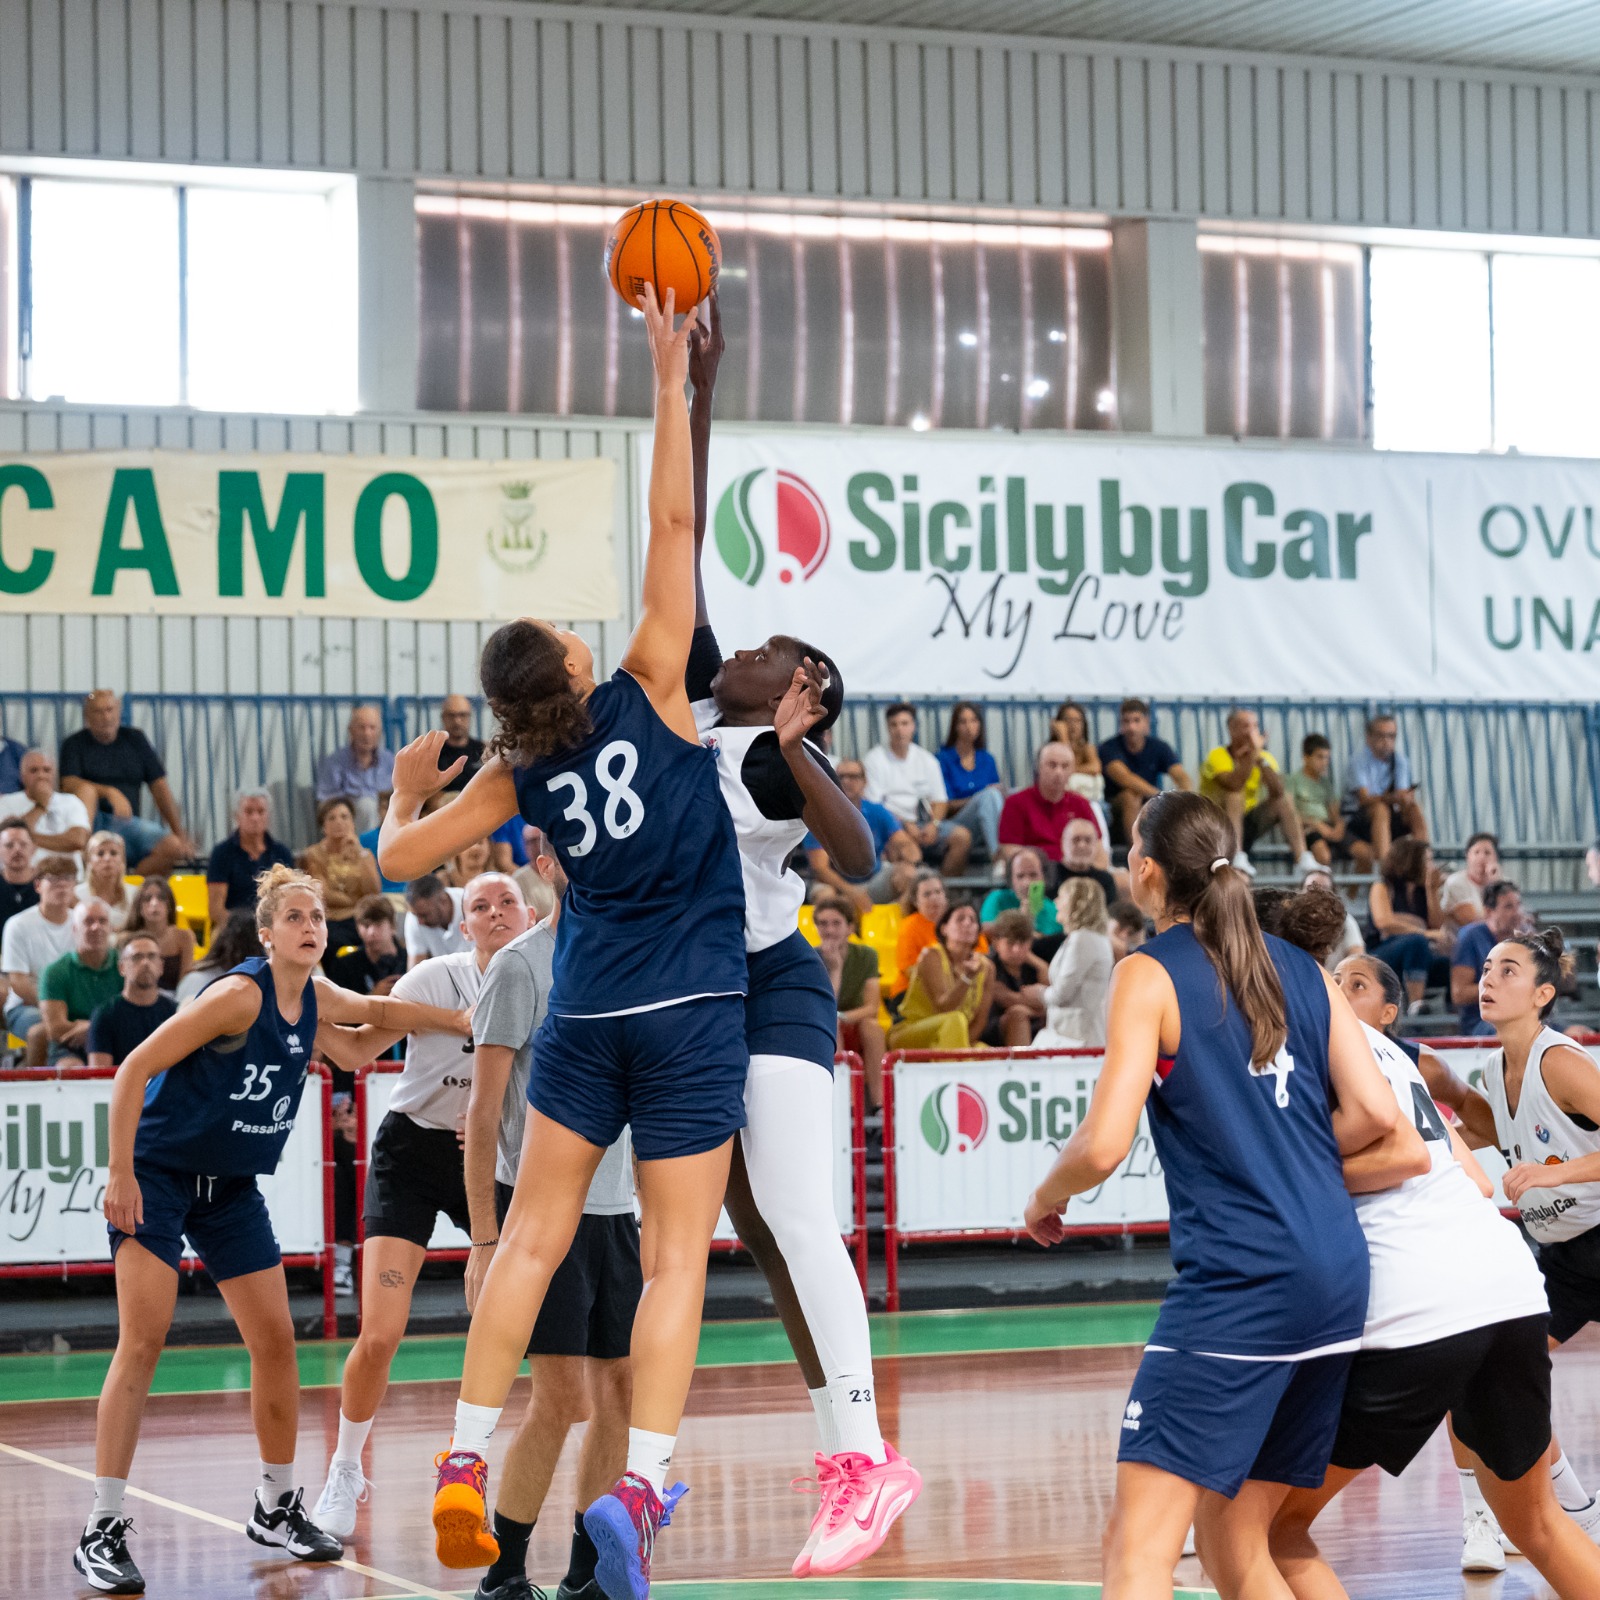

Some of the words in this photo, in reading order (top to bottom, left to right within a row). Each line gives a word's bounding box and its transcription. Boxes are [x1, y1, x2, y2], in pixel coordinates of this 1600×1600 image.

[0, 464, 438, 602] CAMO
[846, 471, 1085, 597] Sicily
[1099, 478, 1210, 598] by
[1223, 481, 1373, 581] Car
[926, 572, 1032, 679] My
[1053, 574, 1185, 642] Love
[546, 740, 645, 857] 38
[229, 1064, 281, 1101] 35
[998, 1080, 1097, 1143] Sici
[0, 1103, 83, 1184] ily
[1553, 1197, 1578, 1213] Car
[849, 1389, 872, 1403] 23
